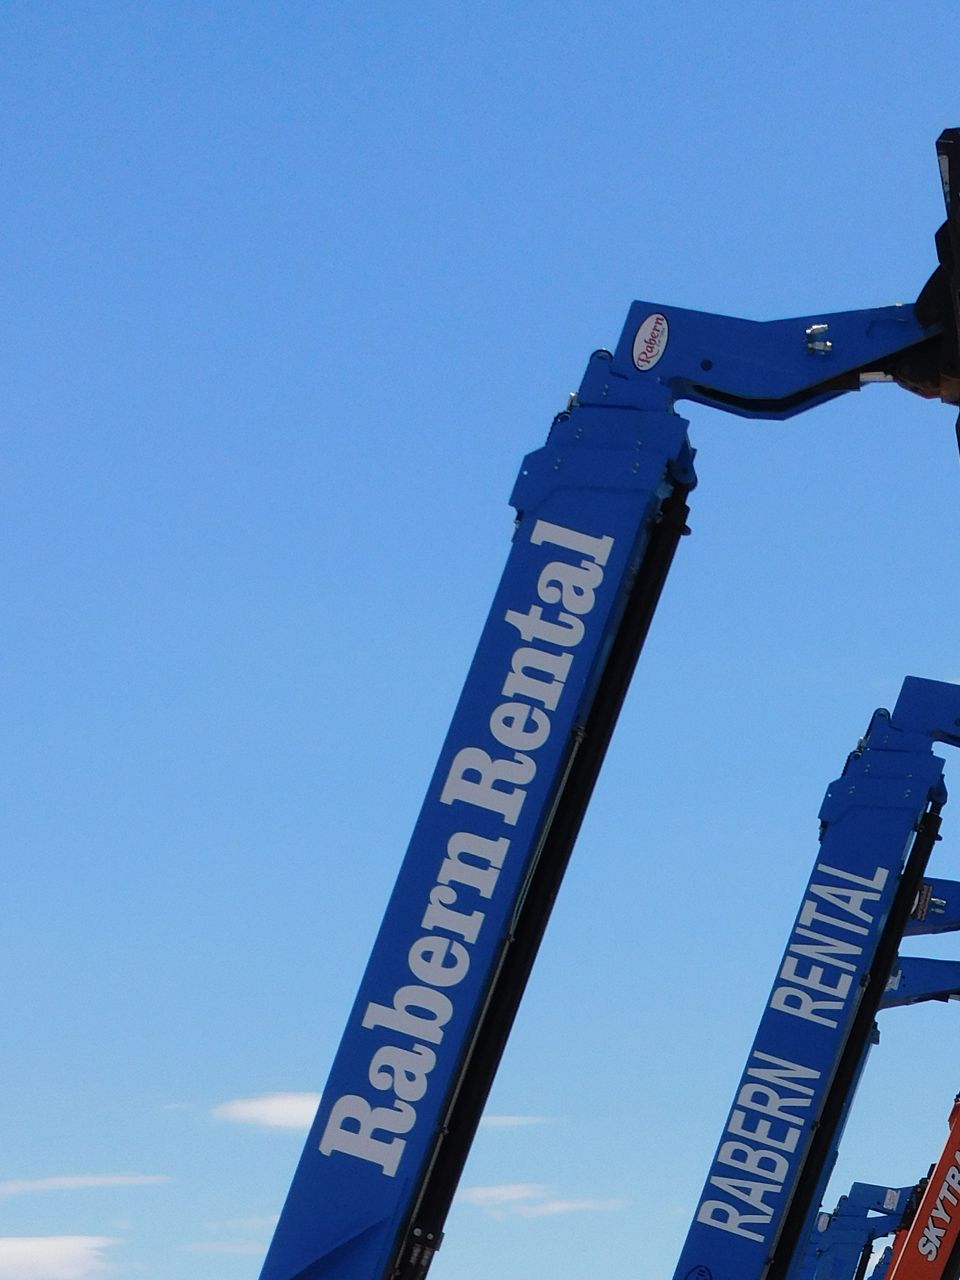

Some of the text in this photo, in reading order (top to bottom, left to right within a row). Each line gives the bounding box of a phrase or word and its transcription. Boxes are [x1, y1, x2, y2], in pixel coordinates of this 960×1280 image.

[637, 317, 664, 367] Rabern
[318, 519, 615, 1179] Rabern Rental
[697, 863, 890, 1243] RABERN RENTAL
